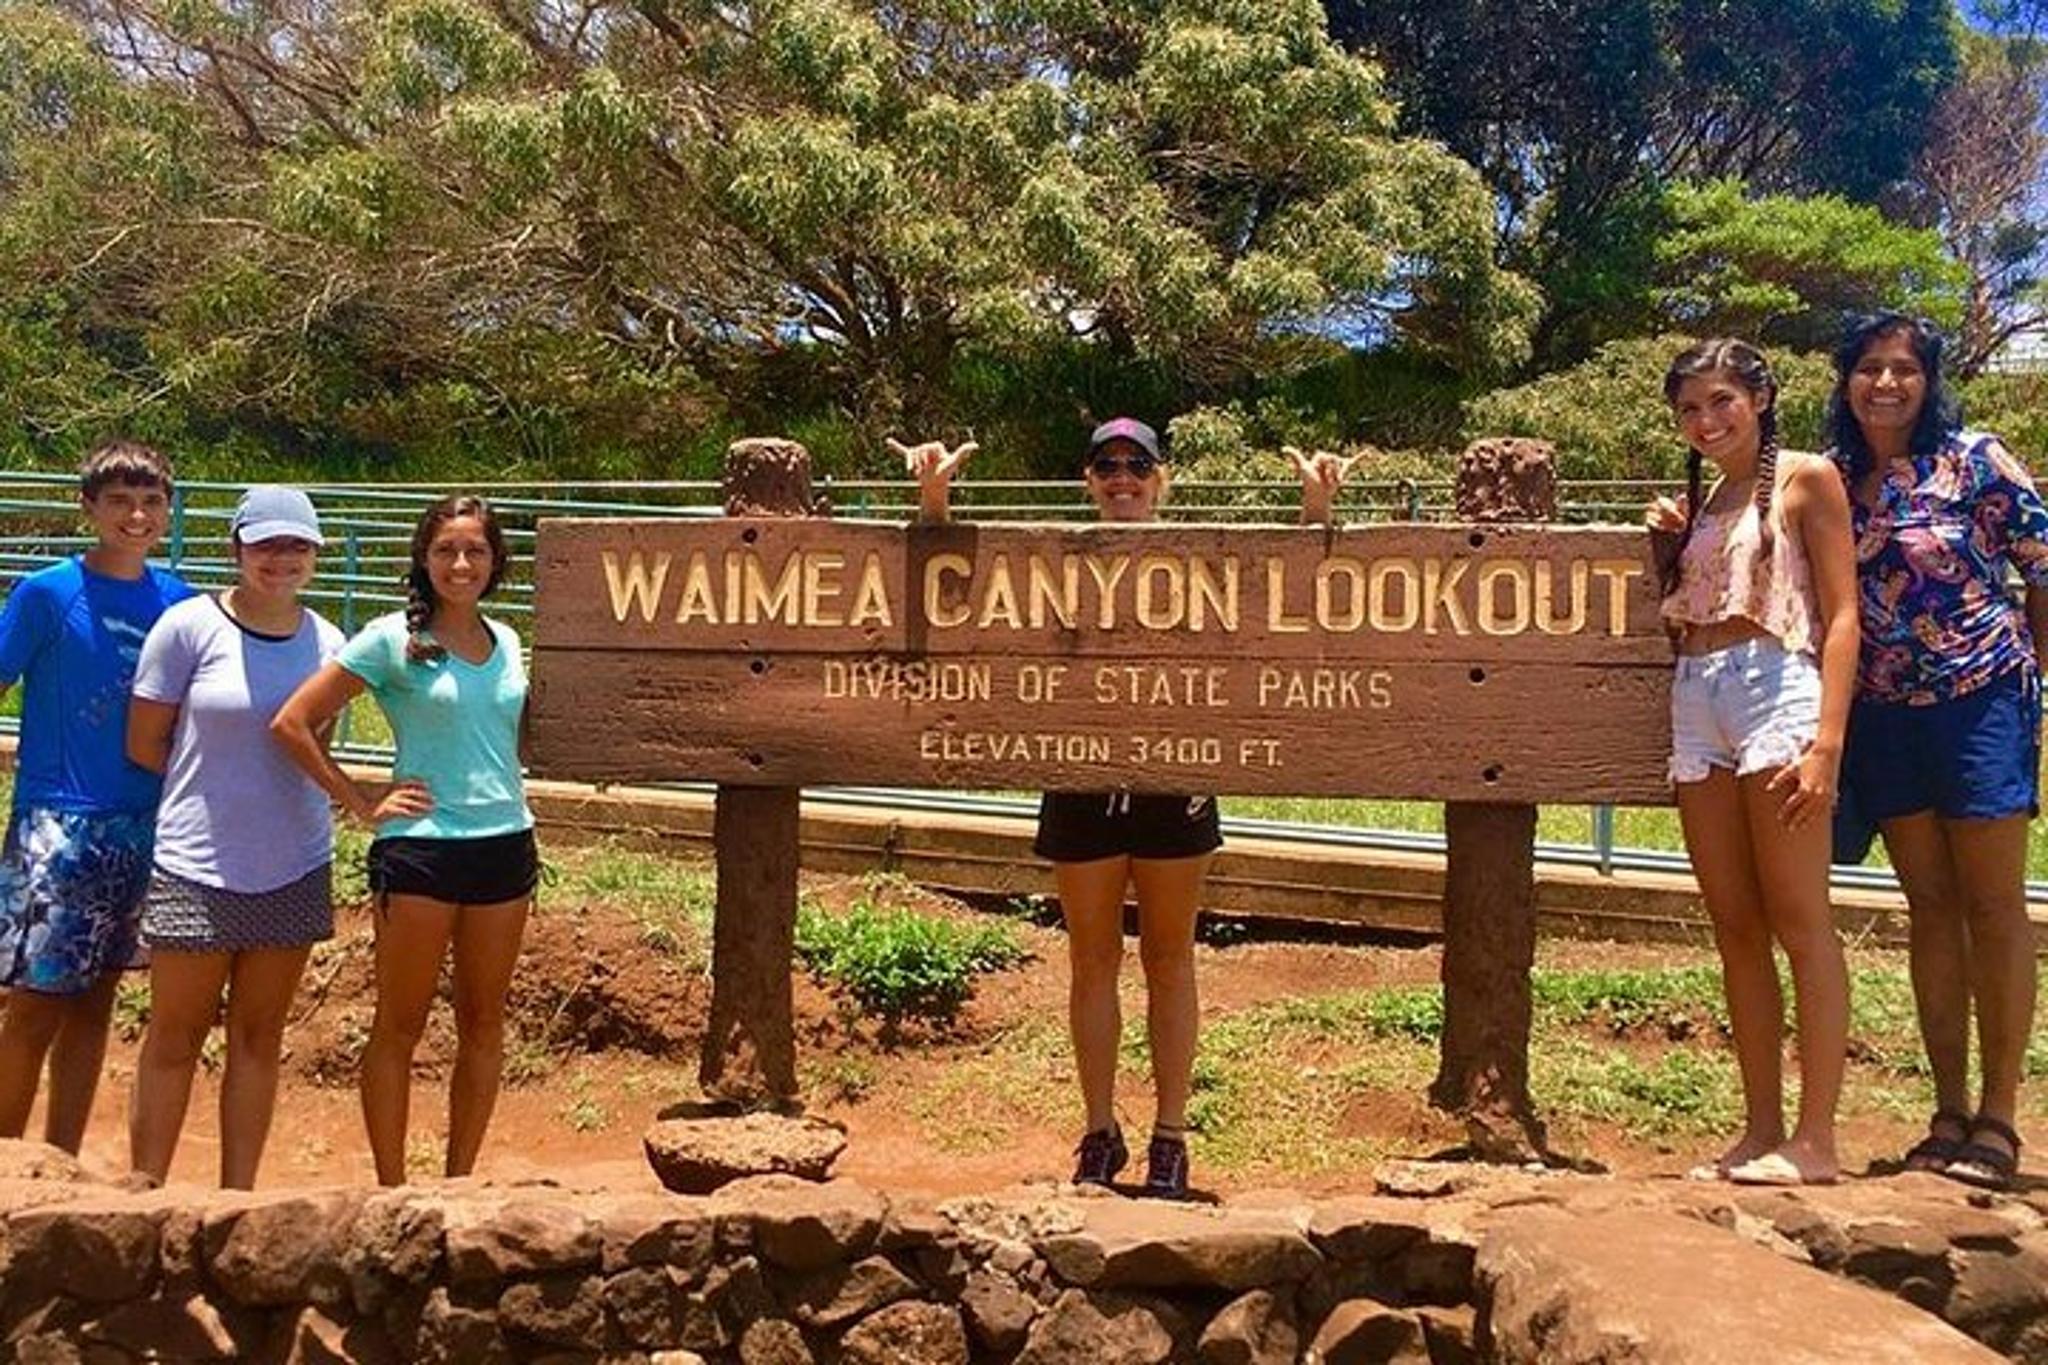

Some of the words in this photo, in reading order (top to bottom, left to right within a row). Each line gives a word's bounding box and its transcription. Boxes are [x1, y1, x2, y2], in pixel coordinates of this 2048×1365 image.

[602, 550, 893, 629] WAIMEA
[924, 553, 1239, 632] CANYON
[1267, 556, 1643, 637] LOOKOUT
[824, 661, 990, 702] DIVISION
[1018, 666, 1068, 703] OF
[1095, 667, 1230, 707] STATE
[1259, 669, 1393, 709] PARKS
[921, 731, 1110, 763] ELEVATION
[1129, 737, 1222, 764] 3400
[1239, 739, 1284, 768] FT.
